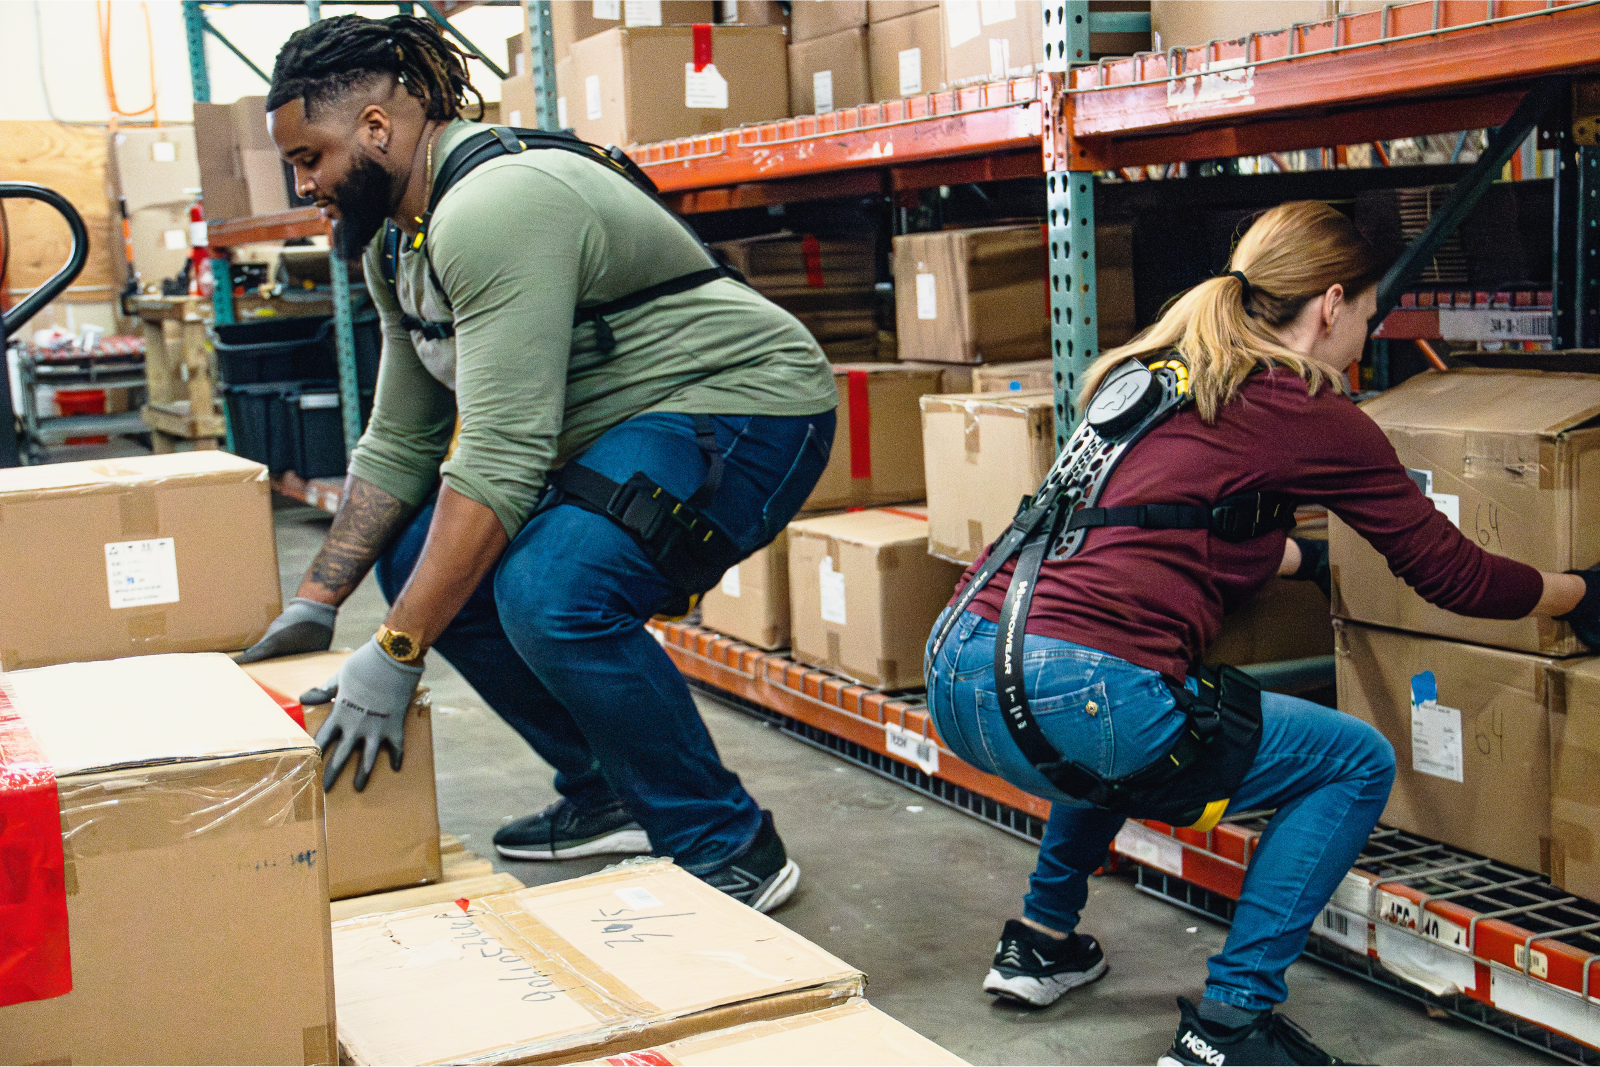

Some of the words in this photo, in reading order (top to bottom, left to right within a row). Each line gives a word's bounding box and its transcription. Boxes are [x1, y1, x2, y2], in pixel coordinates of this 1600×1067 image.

[1475, 503, 1503, 551] 64
[1004, 592, 1023, 675] HEROWEAR
[1181, 1030, 1225, 1066] HOKA
